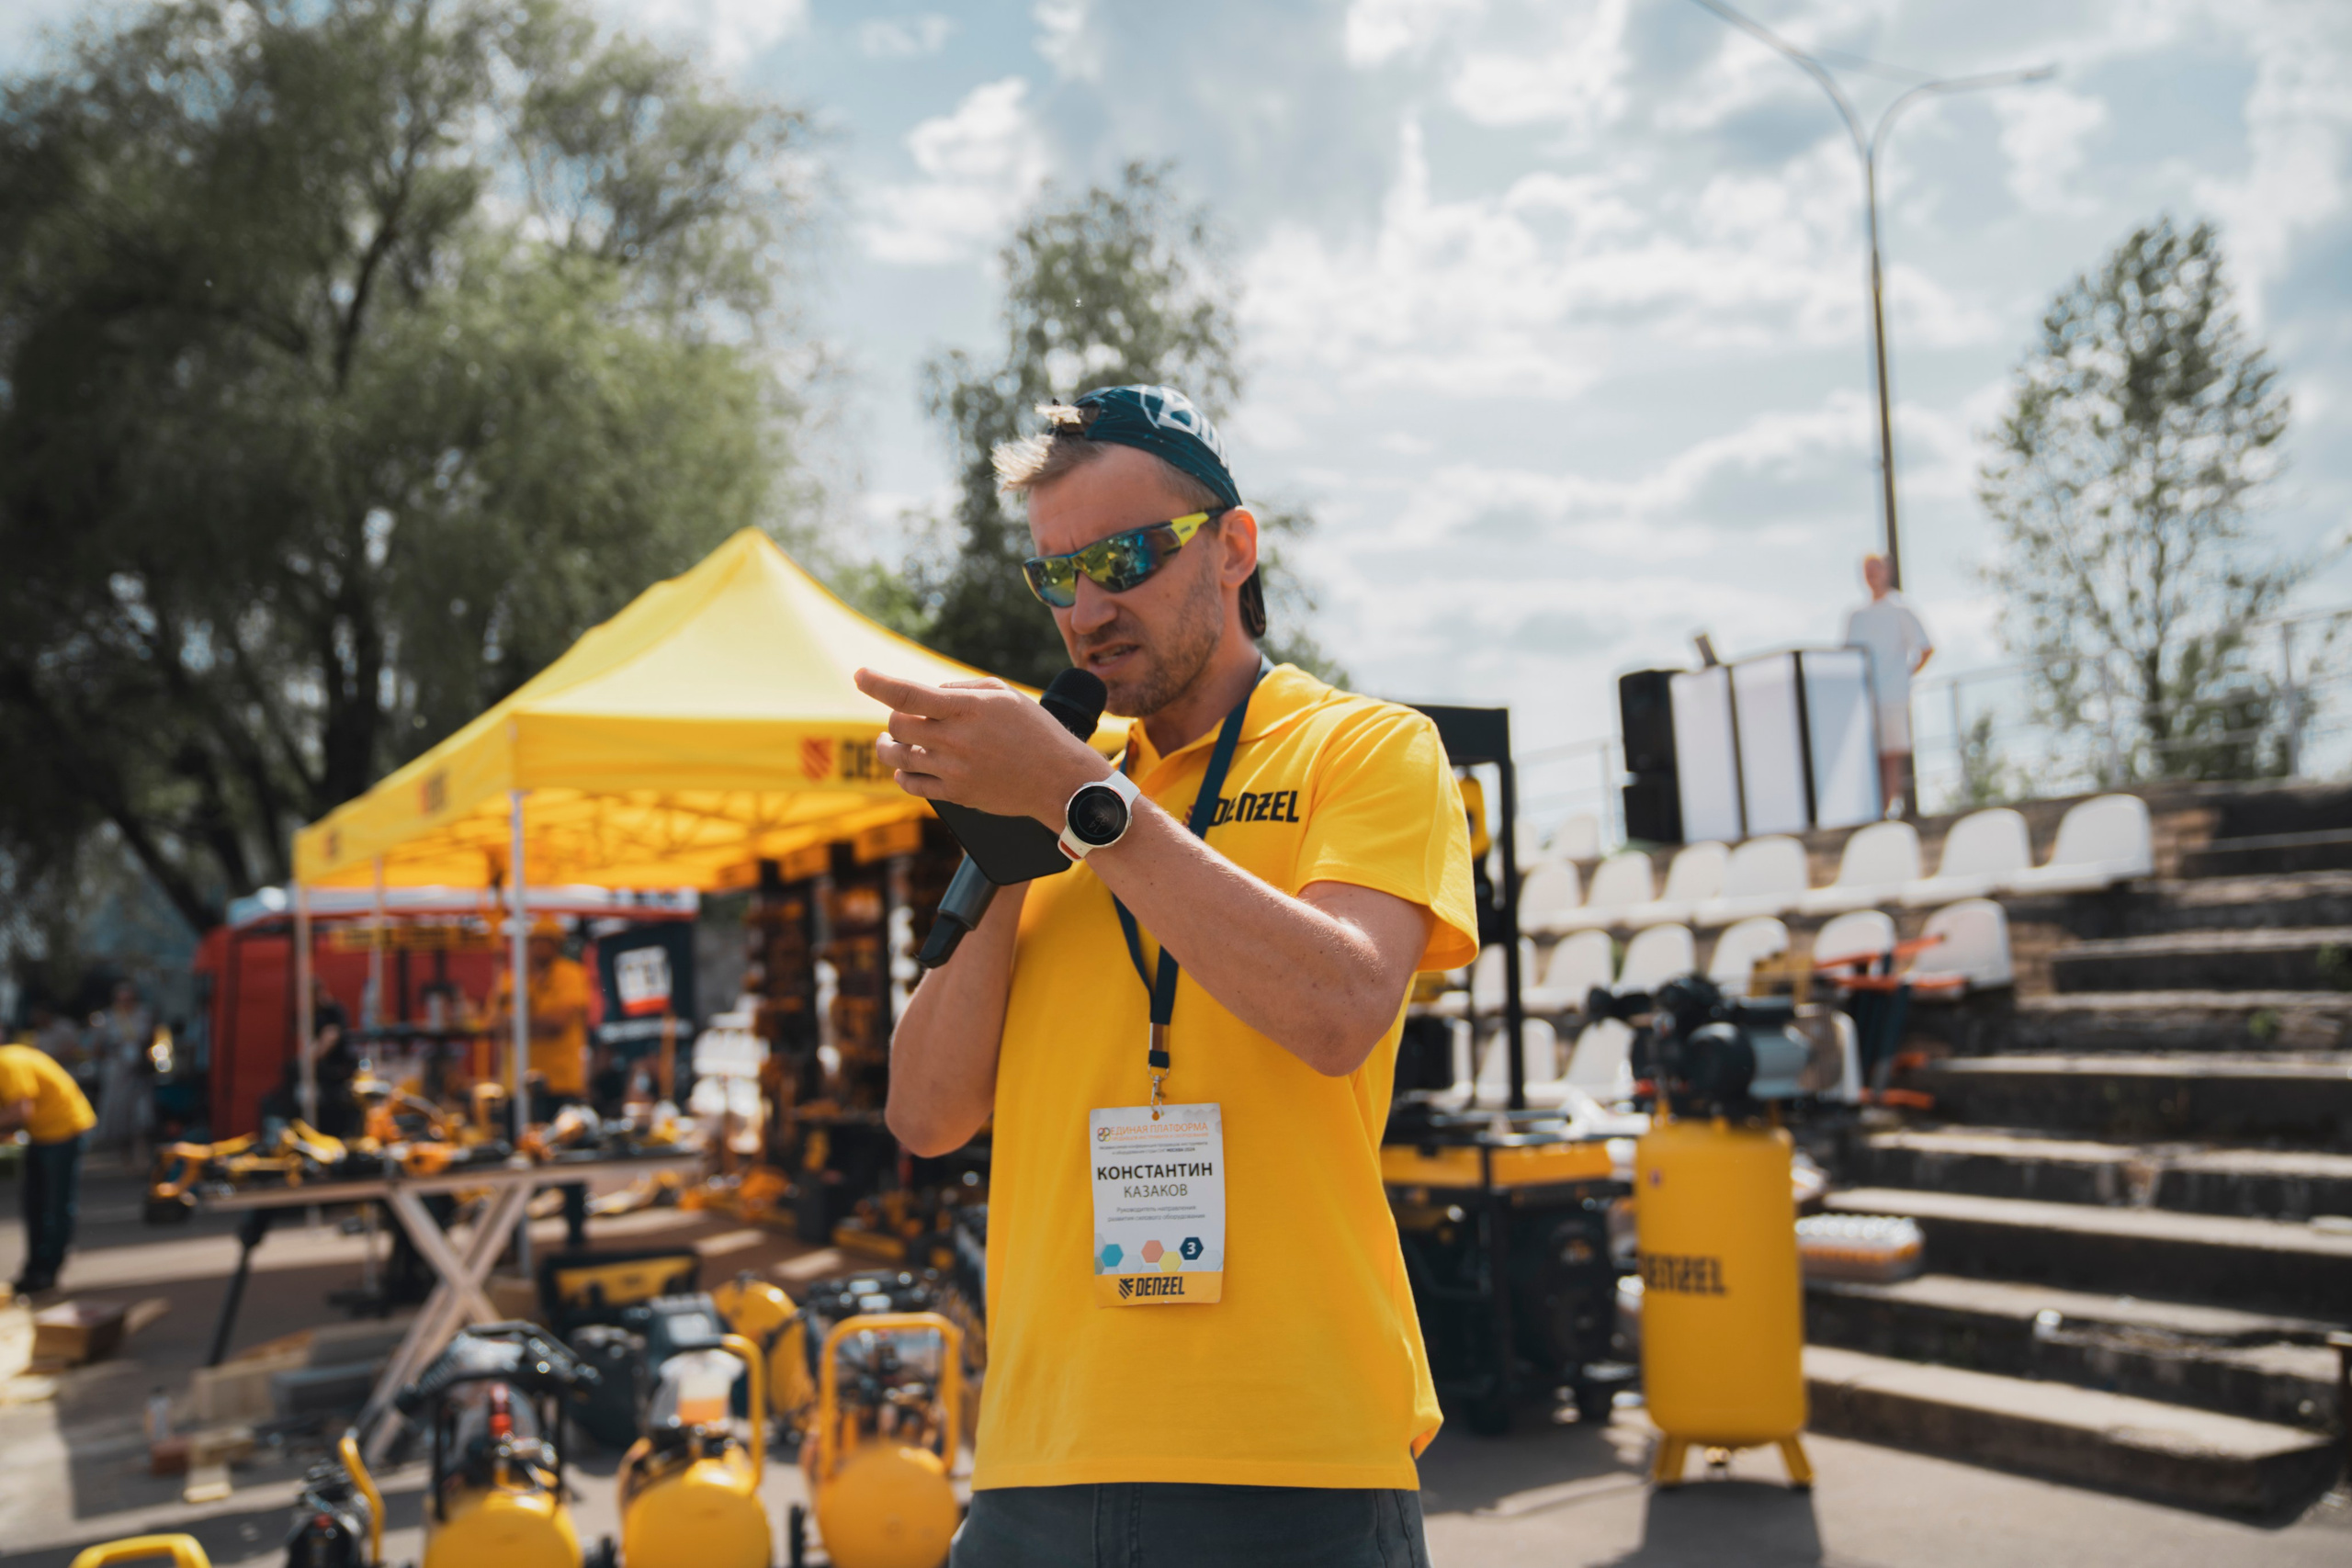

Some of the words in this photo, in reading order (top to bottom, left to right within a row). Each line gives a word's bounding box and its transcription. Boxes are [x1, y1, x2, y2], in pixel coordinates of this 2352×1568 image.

[1207, 791, 1300, 828] DENZEL
[1110, 1125, 1148, 1136] ЕДИНАЯ
[1149, 1122, 1209, 1134] ПЛАТФОРМА
[1097, 1162, 1213, 1180] КОНСТАНТИН
[1124, 1184, 1188, 1198] КАЗАКОВ
[1186, 1242, 1197, 1255] 3
[1136, 1276, 1185, 1296] DENZEL
